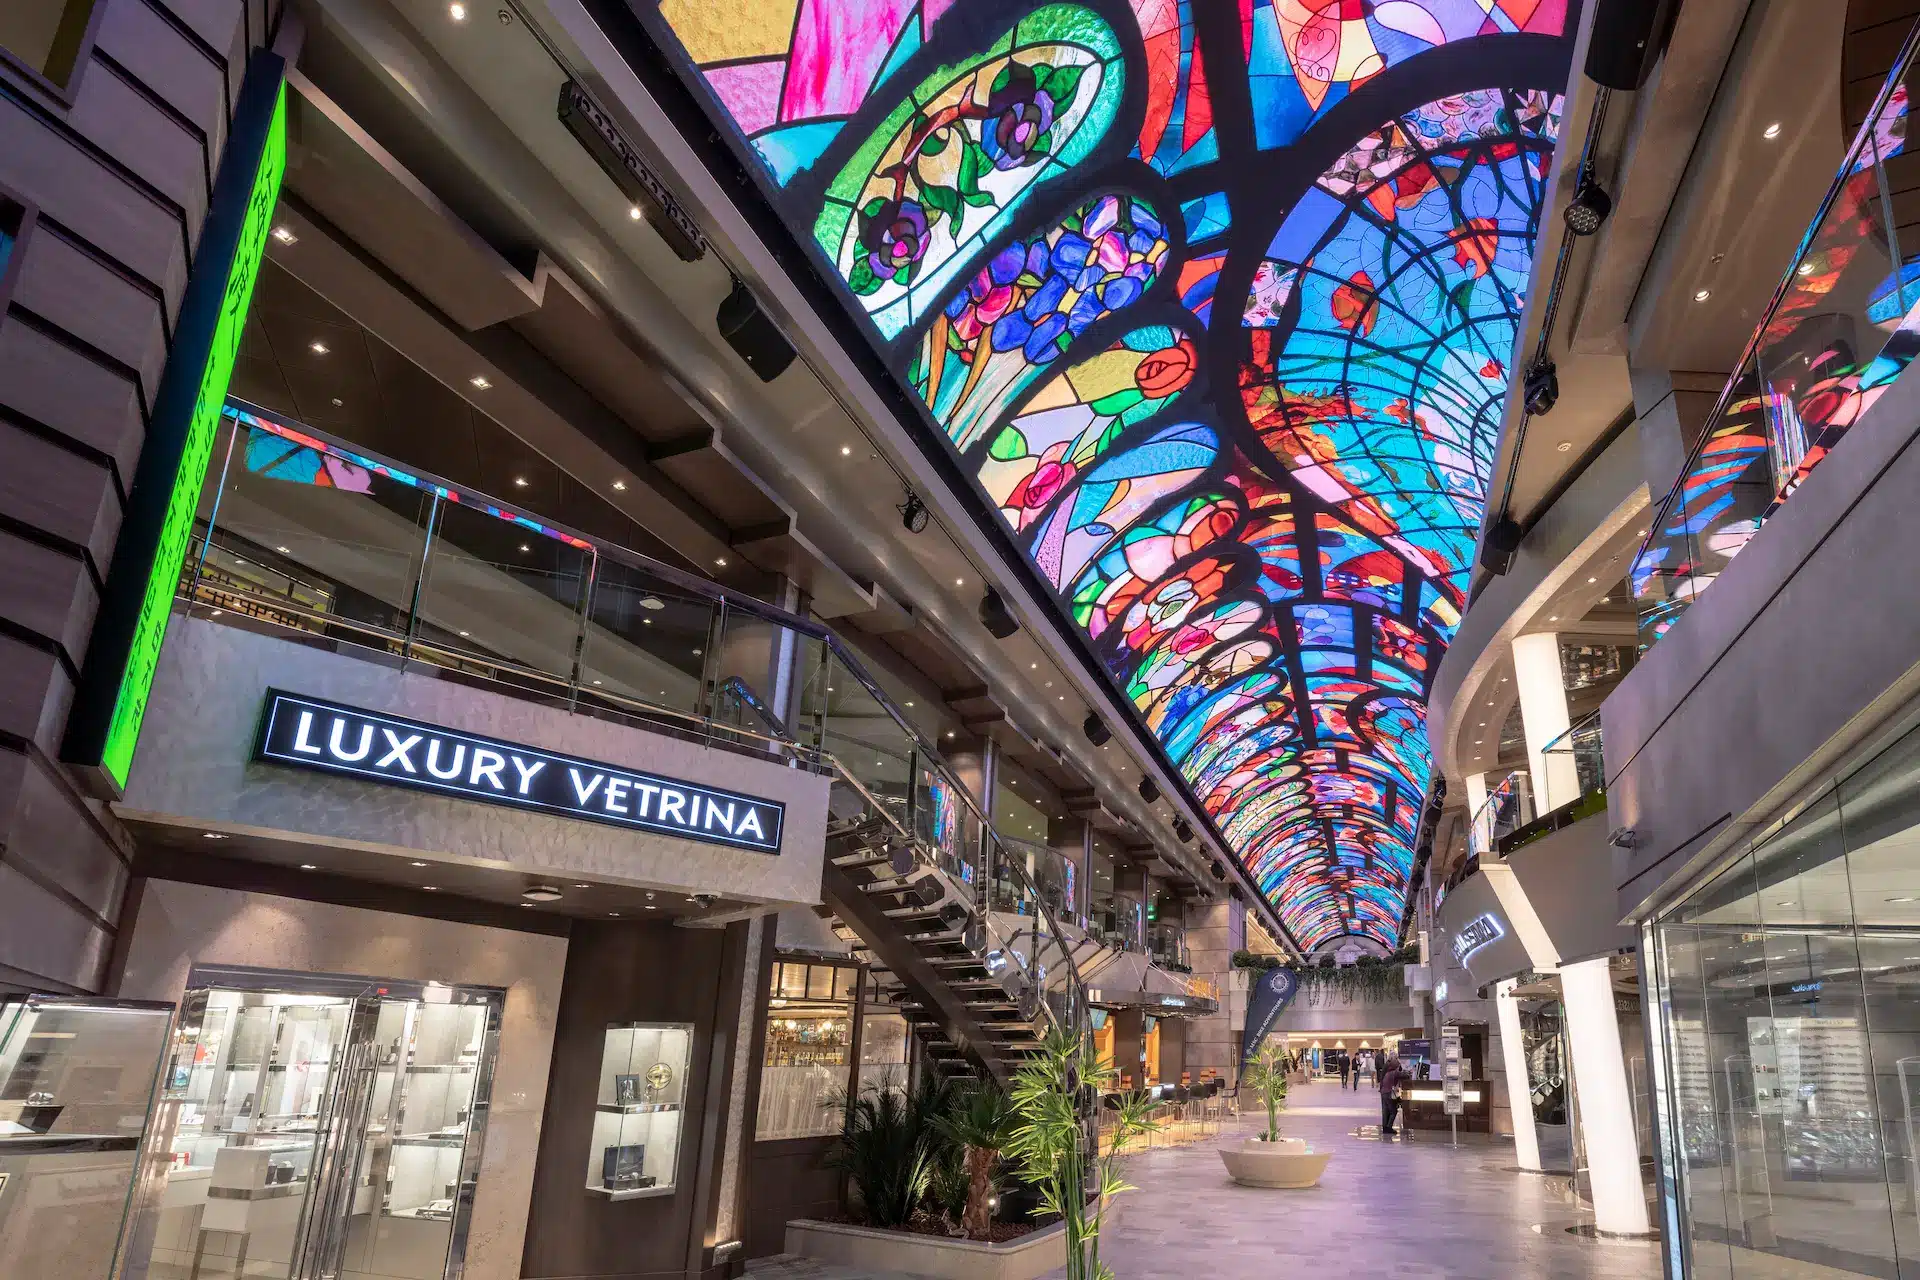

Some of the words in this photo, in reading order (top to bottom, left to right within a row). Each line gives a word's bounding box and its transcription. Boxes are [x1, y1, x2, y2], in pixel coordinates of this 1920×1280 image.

[166, 417, 214, 595] SUSHI
[131, 619, 162, 733] BAR
[293, 711, 546, 795] LUXURY
[569, 768, 765, 840] VETRINA
